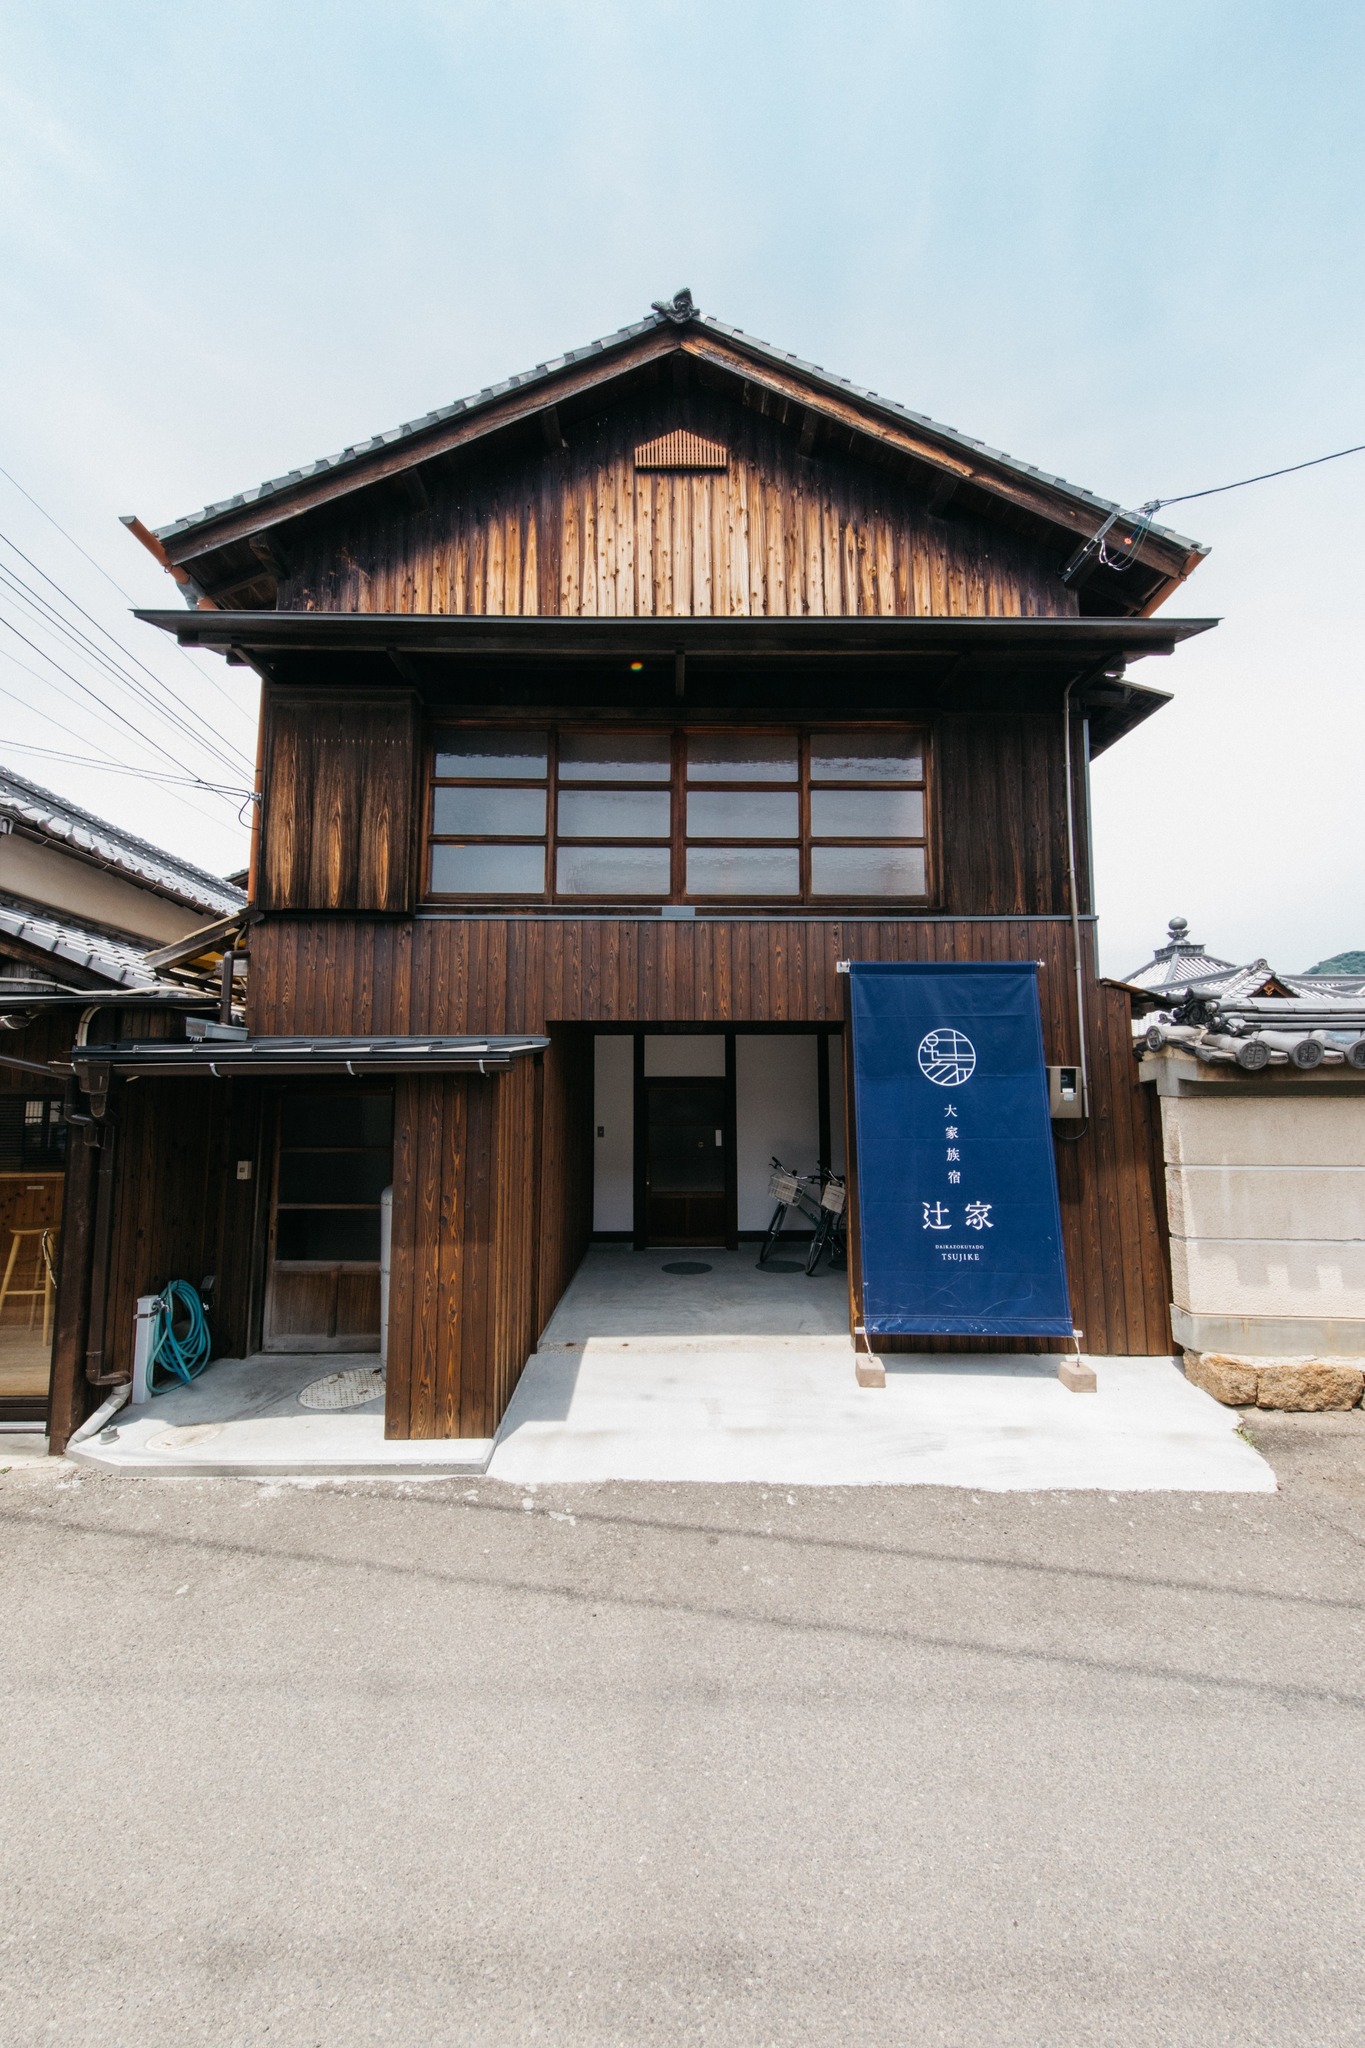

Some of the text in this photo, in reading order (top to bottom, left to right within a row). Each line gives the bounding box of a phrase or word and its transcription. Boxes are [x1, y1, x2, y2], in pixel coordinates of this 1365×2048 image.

[944, 1104, 961, 1184] 大家族宿
[922, 1200, 994, 1230] 辻家
[941, 1253, 980, 1262] TSUJIKE
